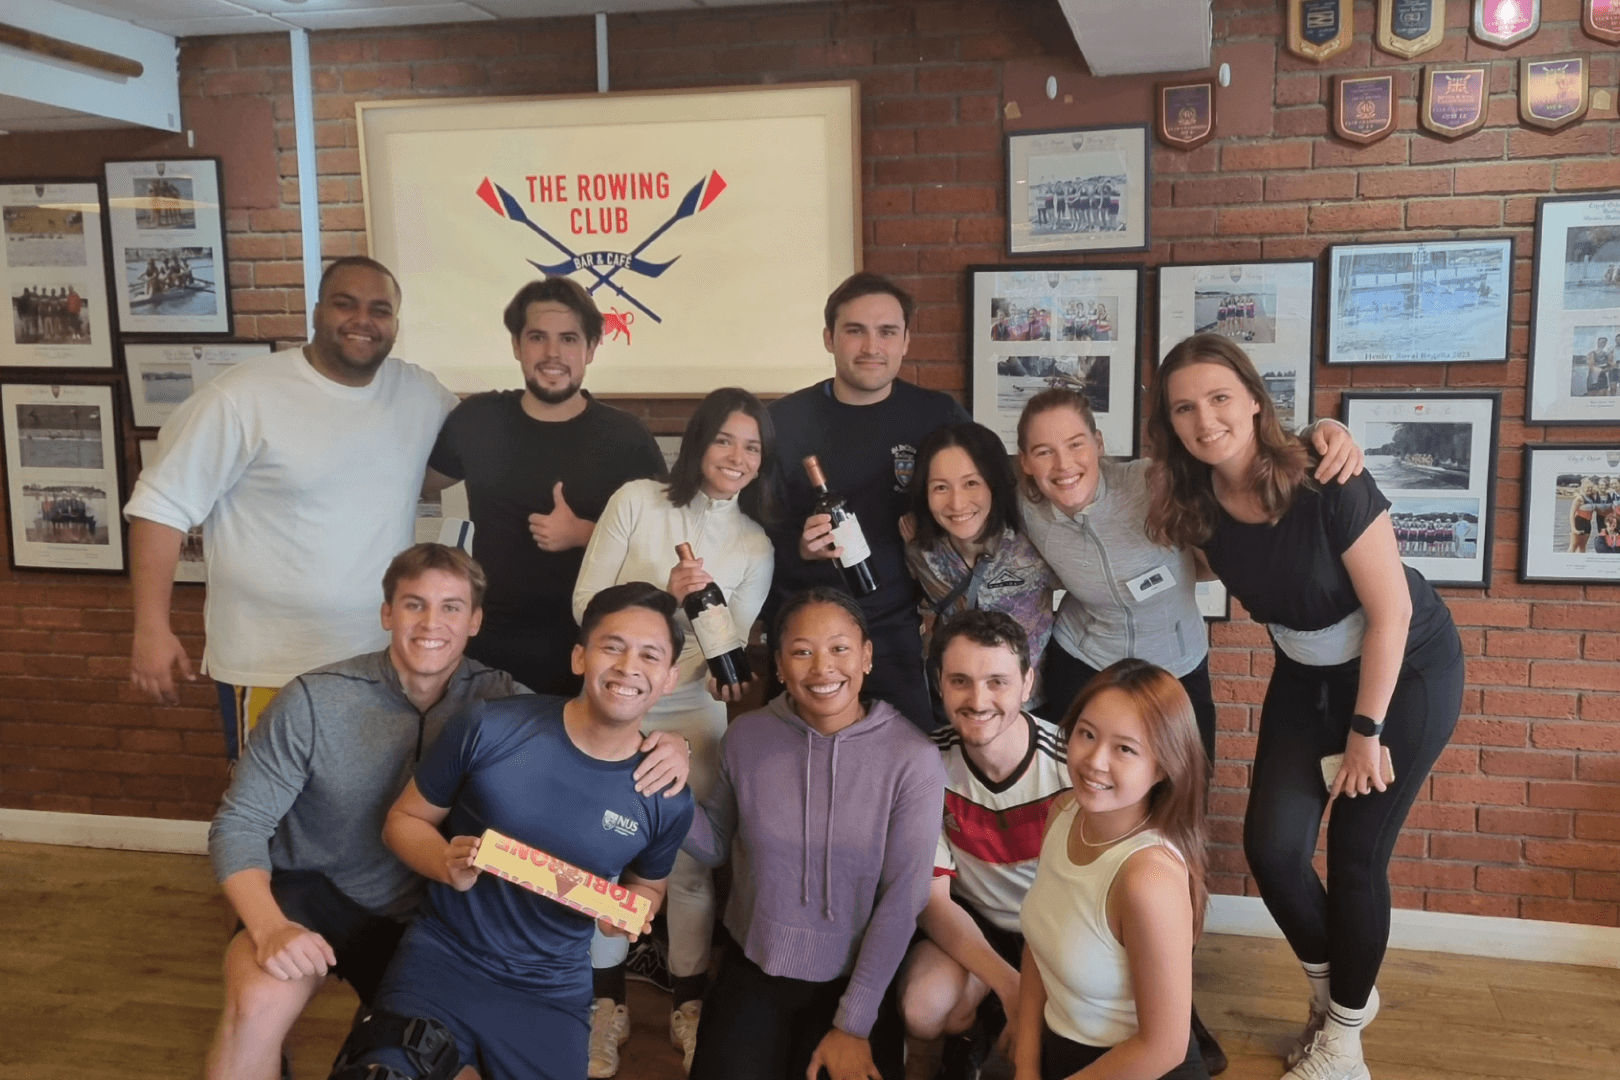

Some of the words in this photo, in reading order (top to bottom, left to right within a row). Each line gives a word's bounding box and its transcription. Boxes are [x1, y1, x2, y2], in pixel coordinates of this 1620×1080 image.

[525, 174, 568, 203] THE
[577, 171, 670, 202] ROWING
[570, 206, 629, 235] CLUB
[573, 253, 594, 269] BAR
[596, 253, 604, 265] &
[617, 815, 639, 832] NUS
